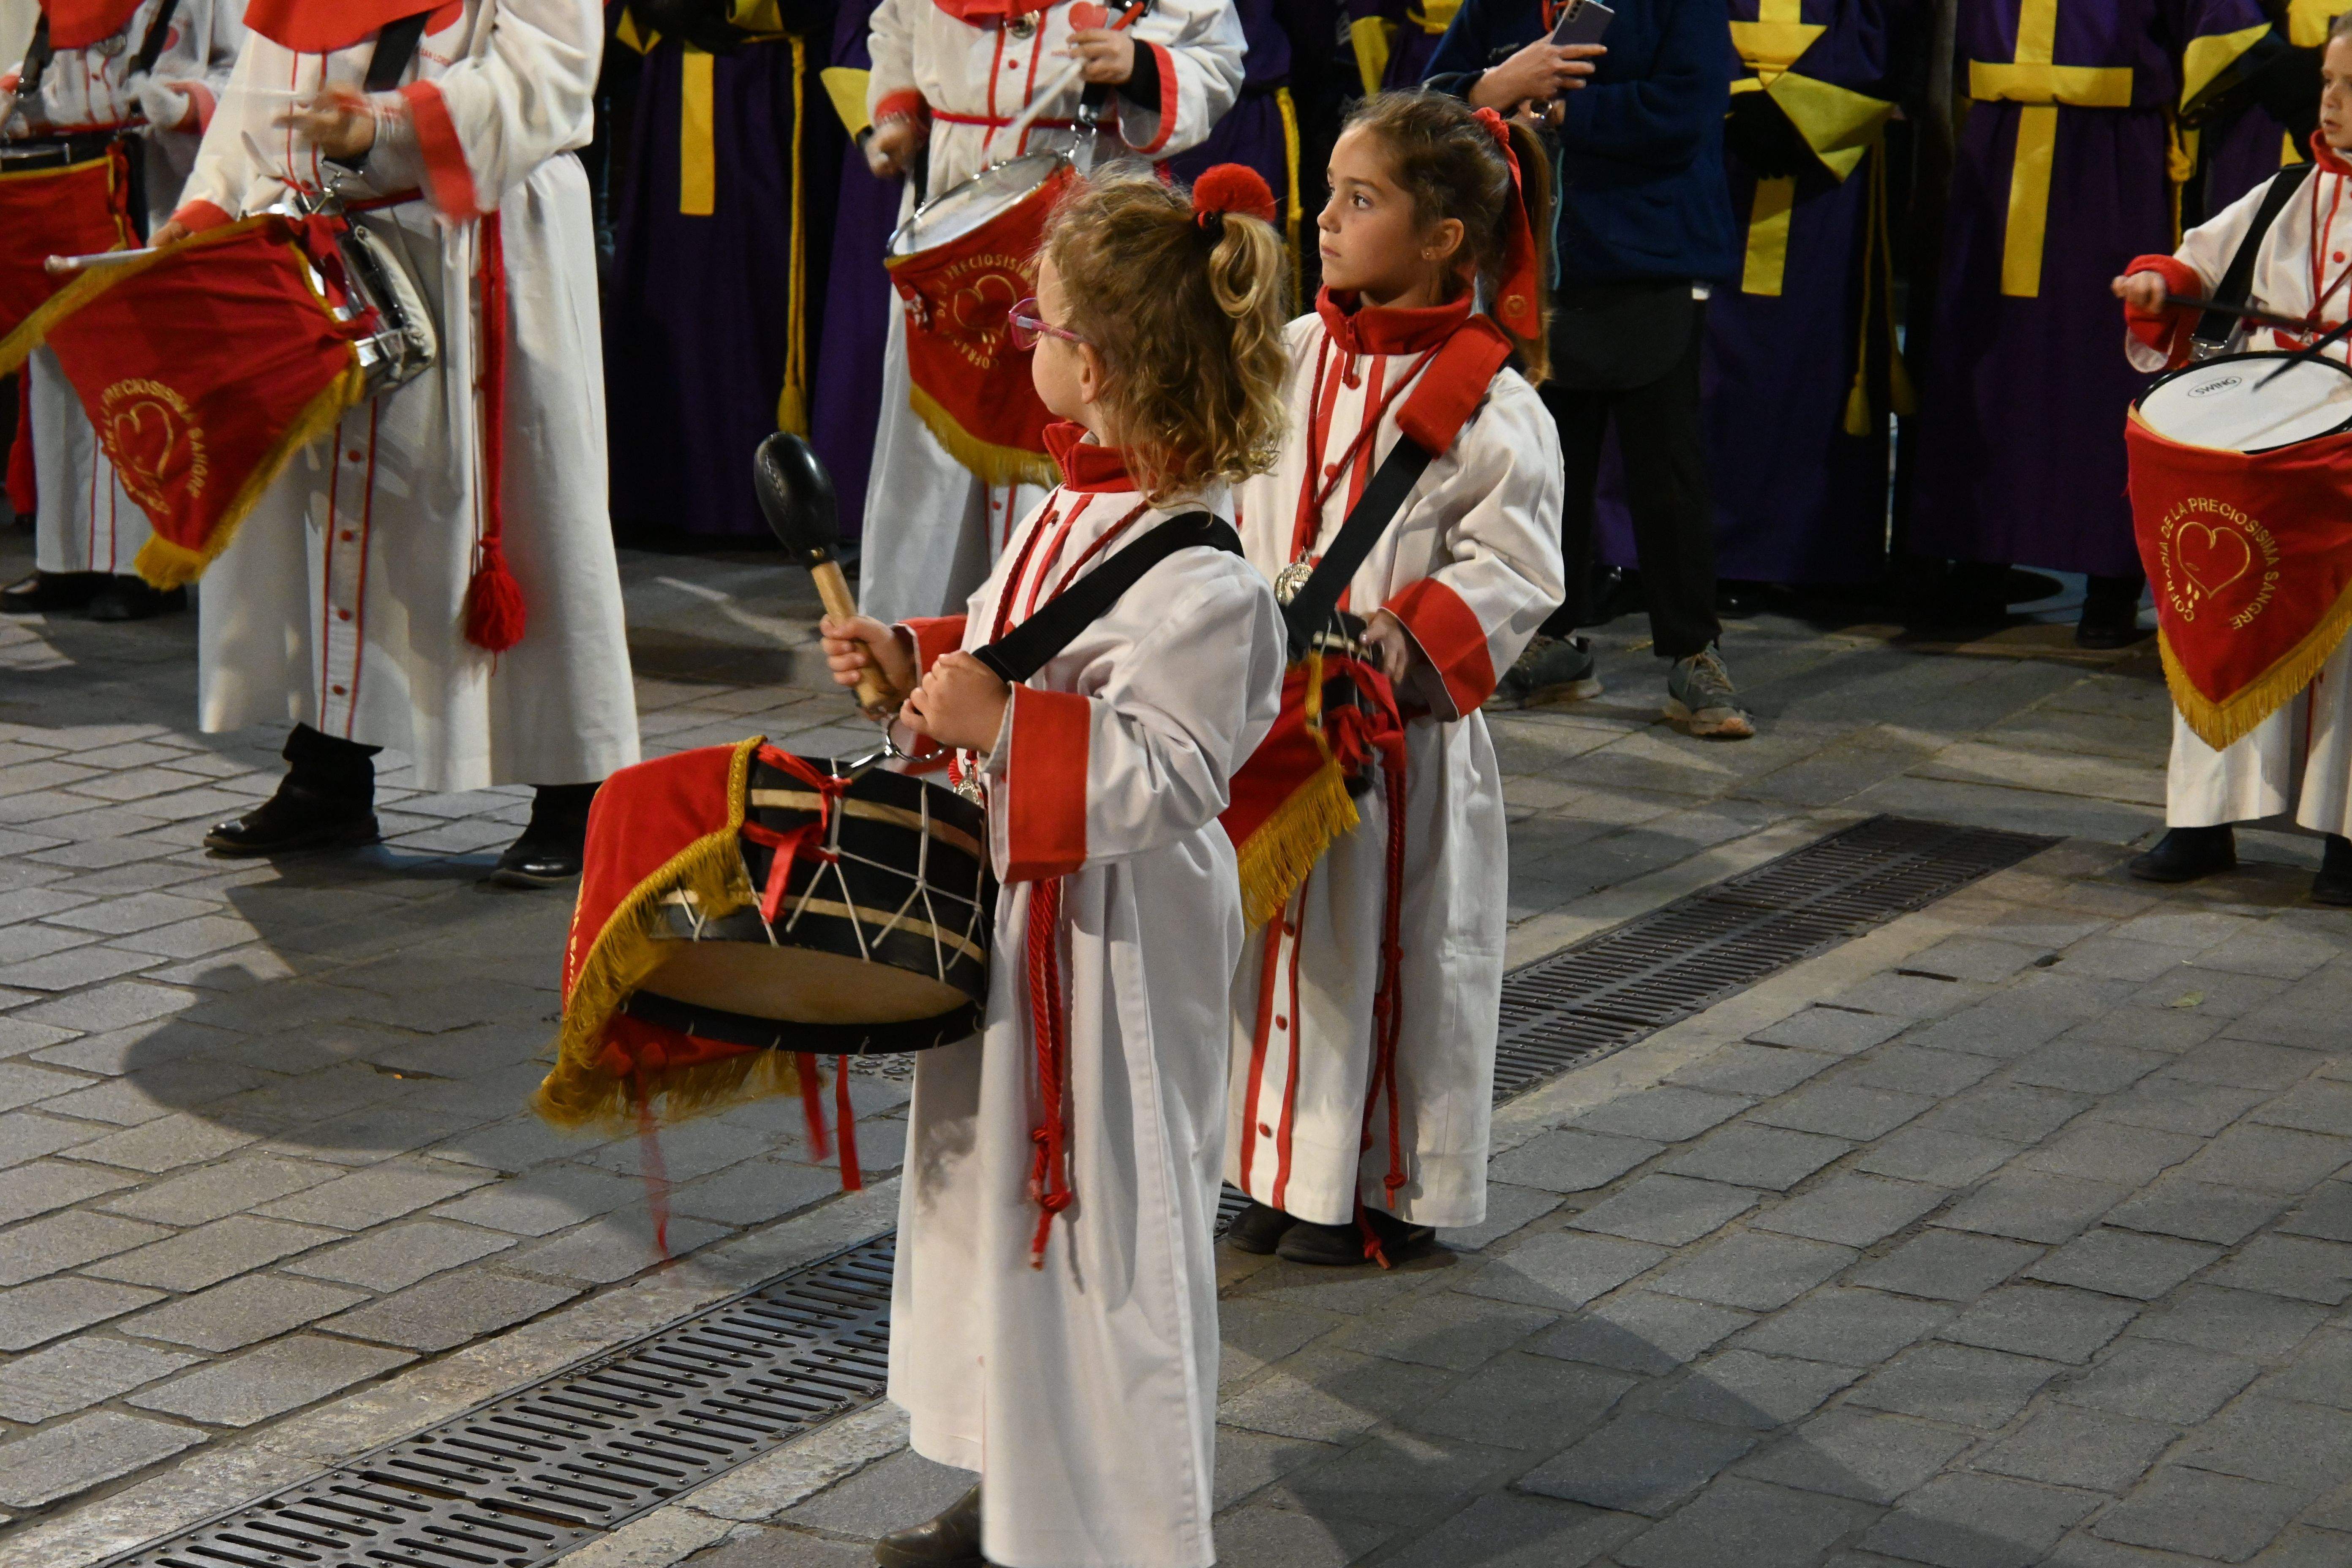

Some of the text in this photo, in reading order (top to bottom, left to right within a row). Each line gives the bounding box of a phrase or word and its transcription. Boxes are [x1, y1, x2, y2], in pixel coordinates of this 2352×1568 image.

[2196, 379, 2237, 395] SWING
[2170, 502, 2189, 521] LA
[2161, 516, 2174, 539] DE
[2187, 498, 2279, 567] PRECIOSISIMA
[2229, 571, 2279, 630] SANGRE
